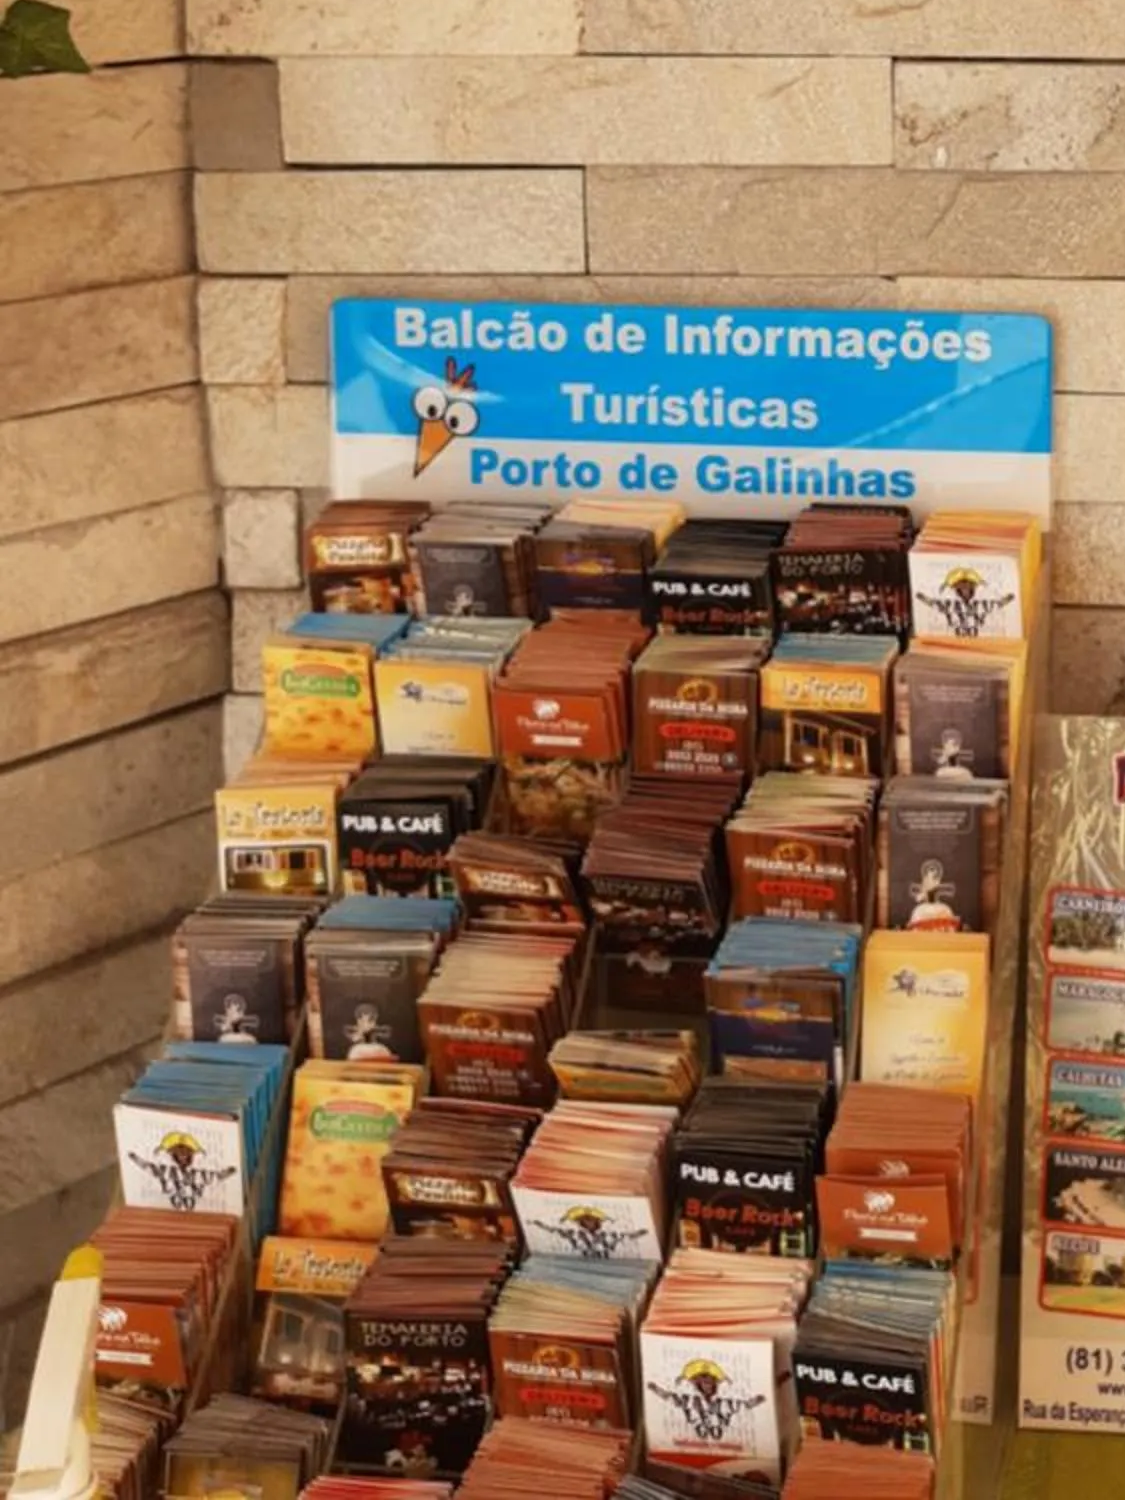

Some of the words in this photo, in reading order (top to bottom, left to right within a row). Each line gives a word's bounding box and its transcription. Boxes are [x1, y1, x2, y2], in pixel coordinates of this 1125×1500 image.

[393, 307, 568, 351] Balcão
[584, 314, 644, 356] de
[664, 316, 992, 370] Informações
[561, 383, 819, 430] Turísticas
[470, 449, 600, 489] Porto
[618, 452, 678, 492] de
[694, 454, 916, 499] Galinhas
[652, 580, 687, 596] PUB
[689, 581, 705, 596] &
[708, 581, 752, 598] CAFÉ
[342, 812, 378, 832] PUB
[381, 815, 396, 832] &
[399, 812, 444, 834] CAFÉ
[1053, 1151, 1098, 1171] SANTO
[680, 1162, 720, 1184] PUB
[723, 1167, 741, 1188] &
[743, 1171, 796, 1193] CAFÉ
[360, 1322, 469, 1336] TEMAKERIA
[364, 1335, 393, 1348] DO
[400, 1335, 466, 1348] PORTO
[1065, 1346, 1114, 1376] (81)
[796, 1362, 838, 1385] PUB
[841, 1367, 860, 1388] &
[862, 1369, 917, 1396] CAFÉ
[804, 1395, 859, 1420] Beer
[1023, 1399, 1050, 1419] Rua
[1051, 1402, 1068, 1421] da
